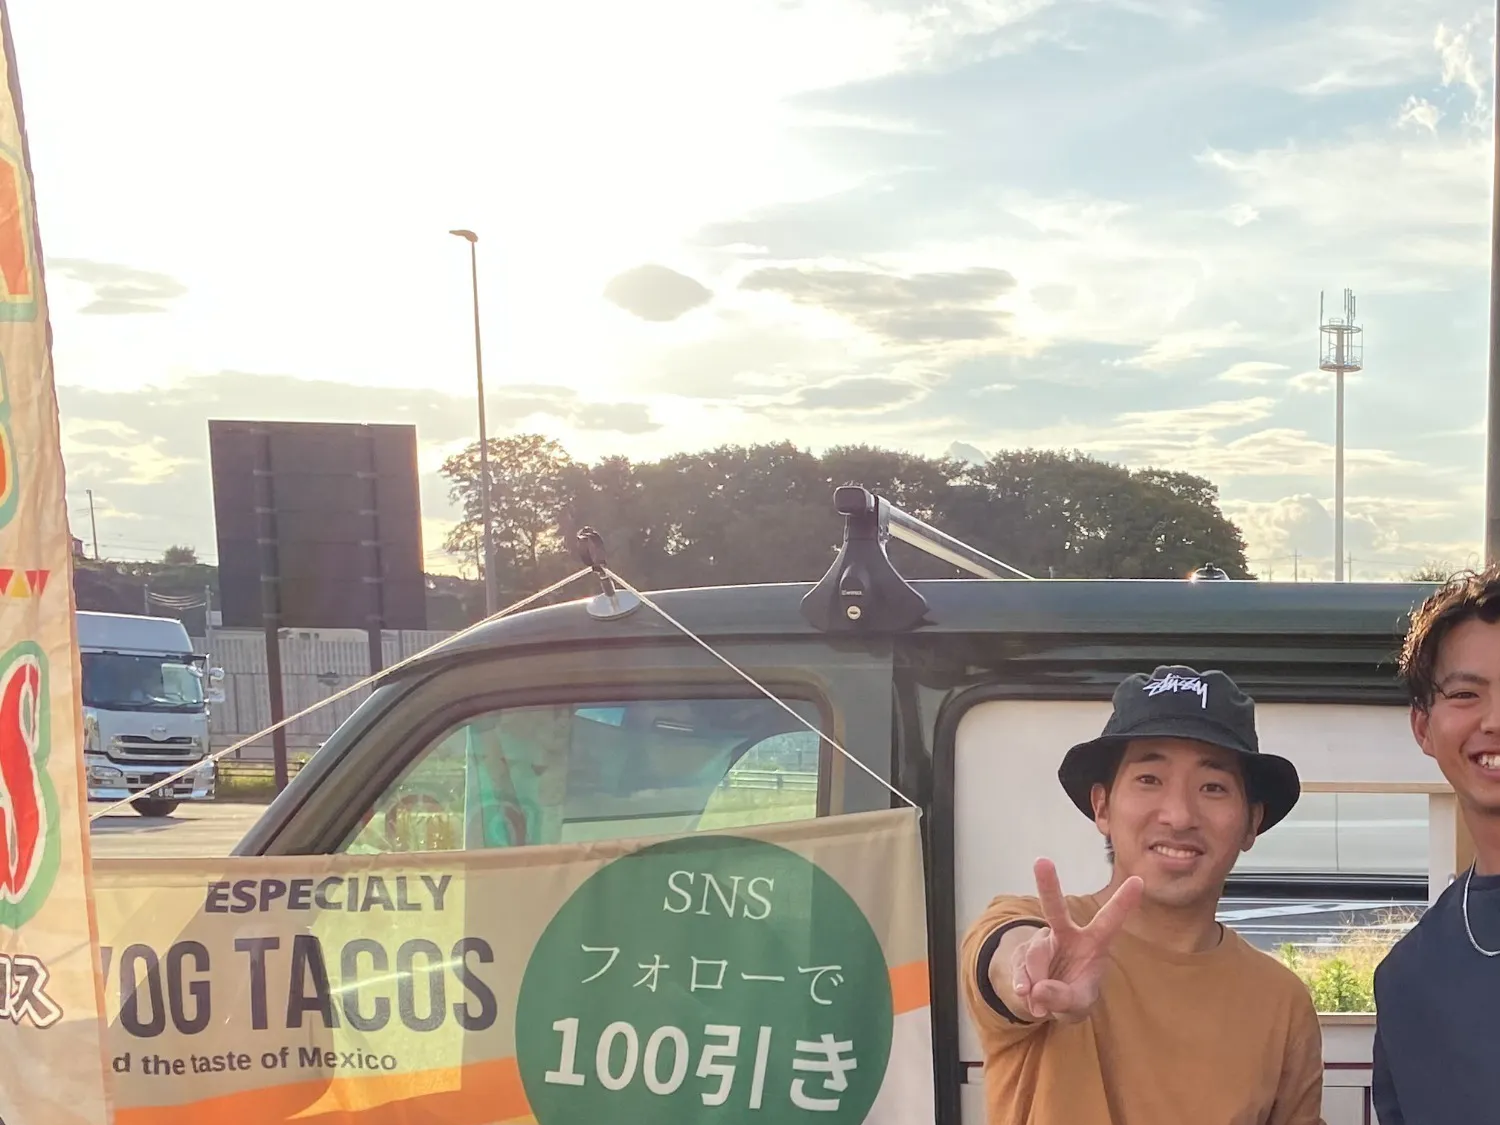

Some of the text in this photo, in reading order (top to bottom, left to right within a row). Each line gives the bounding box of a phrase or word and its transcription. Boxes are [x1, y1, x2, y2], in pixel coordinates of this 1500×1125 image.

[204, 875, 453, 913] ESPECIALY
[663, 870, 775, 920] SNS
[234, 935, 498, 1032] TACOS
[581, 943, 844, 1005] フォローで
[142, 1054, 185, 1075] the
[191, 1051, 252, 1072] taste
[261, 1046, 290, 1069] of
[298, 1046, 398, 1071] Mexico
[545, 1017, 857, 1111] 100引き
